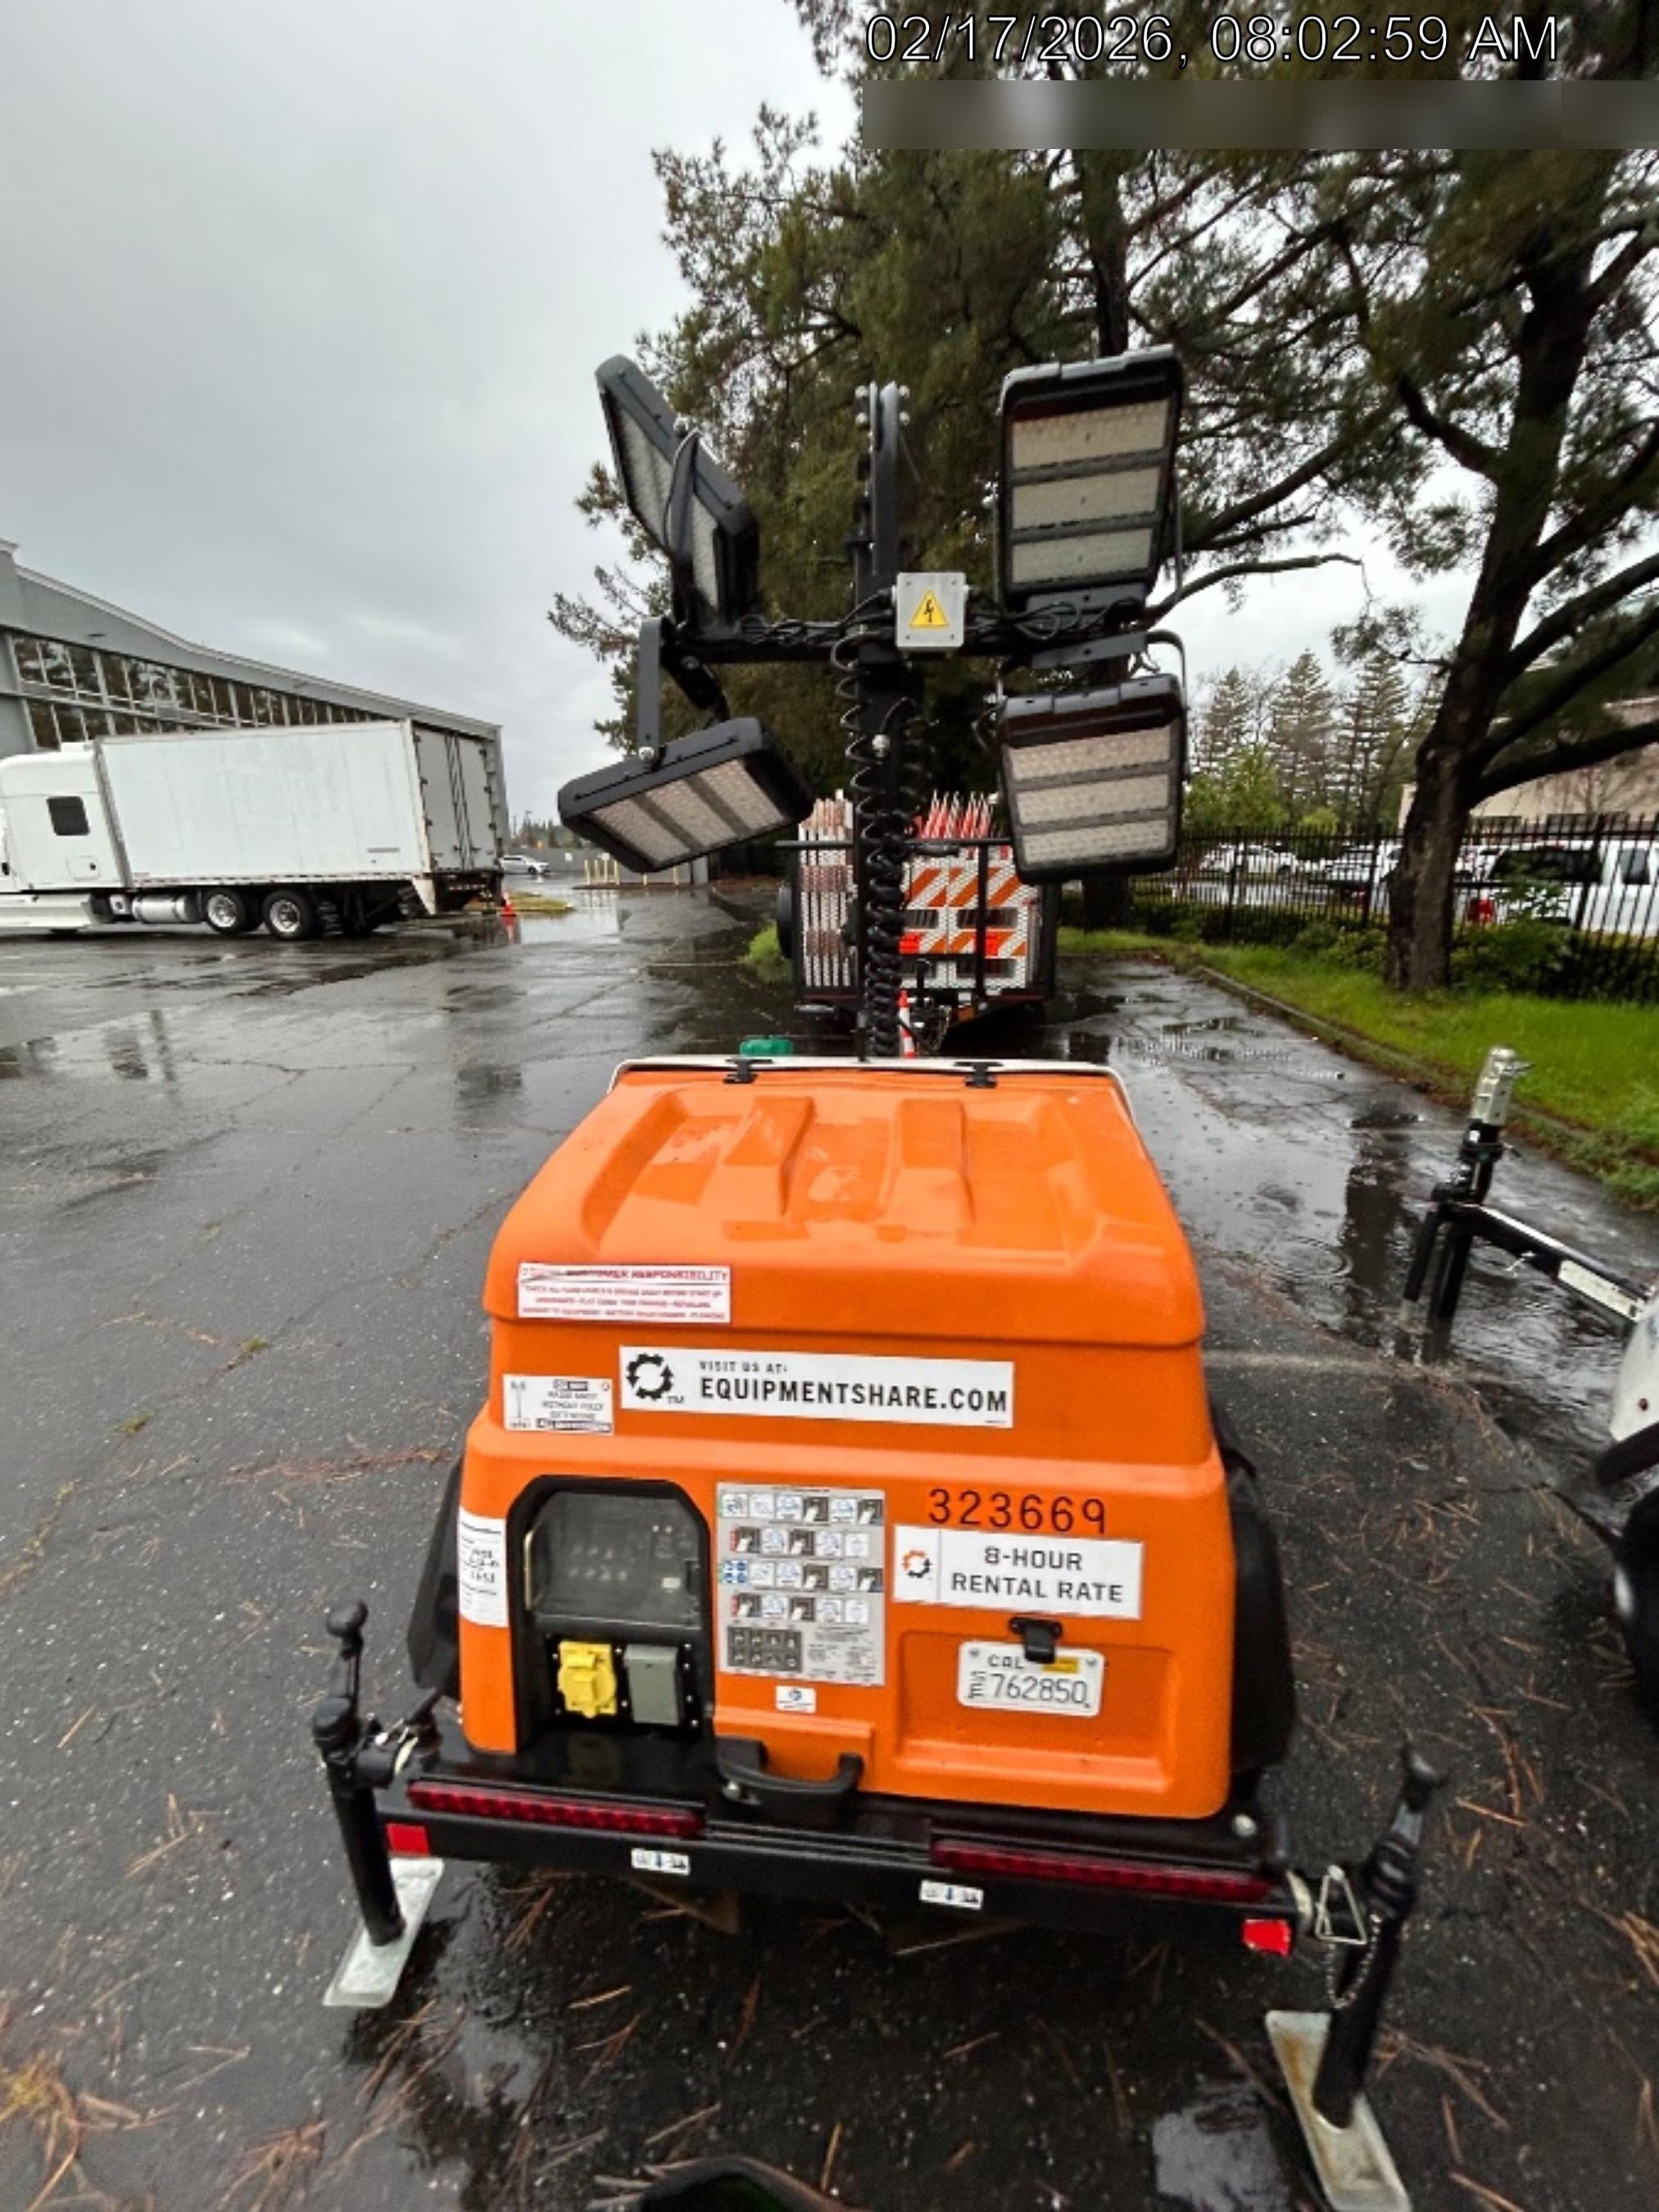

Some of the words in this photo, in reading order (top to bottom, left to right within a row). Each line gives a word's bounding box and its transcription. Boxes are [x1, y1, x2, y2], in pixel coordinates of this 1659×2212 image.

[699, 1360, 737, 1371] VISIT
[742, 1363, 760, 1373] US
[700, 1377, 1007, 1412] EQUIPMENTSHARE.COM
[928, 1489, 1105, 1534] 323669
[984, 1547, 1082, 1571] 8-HOUR
[951, 1572, 1049, 1598] RENTAL
[1057, 1581, 1123, 1602] RATE
[988, 1655, 1024, 1670] CAL
[990, 1673, 1087, 1705] 762850
